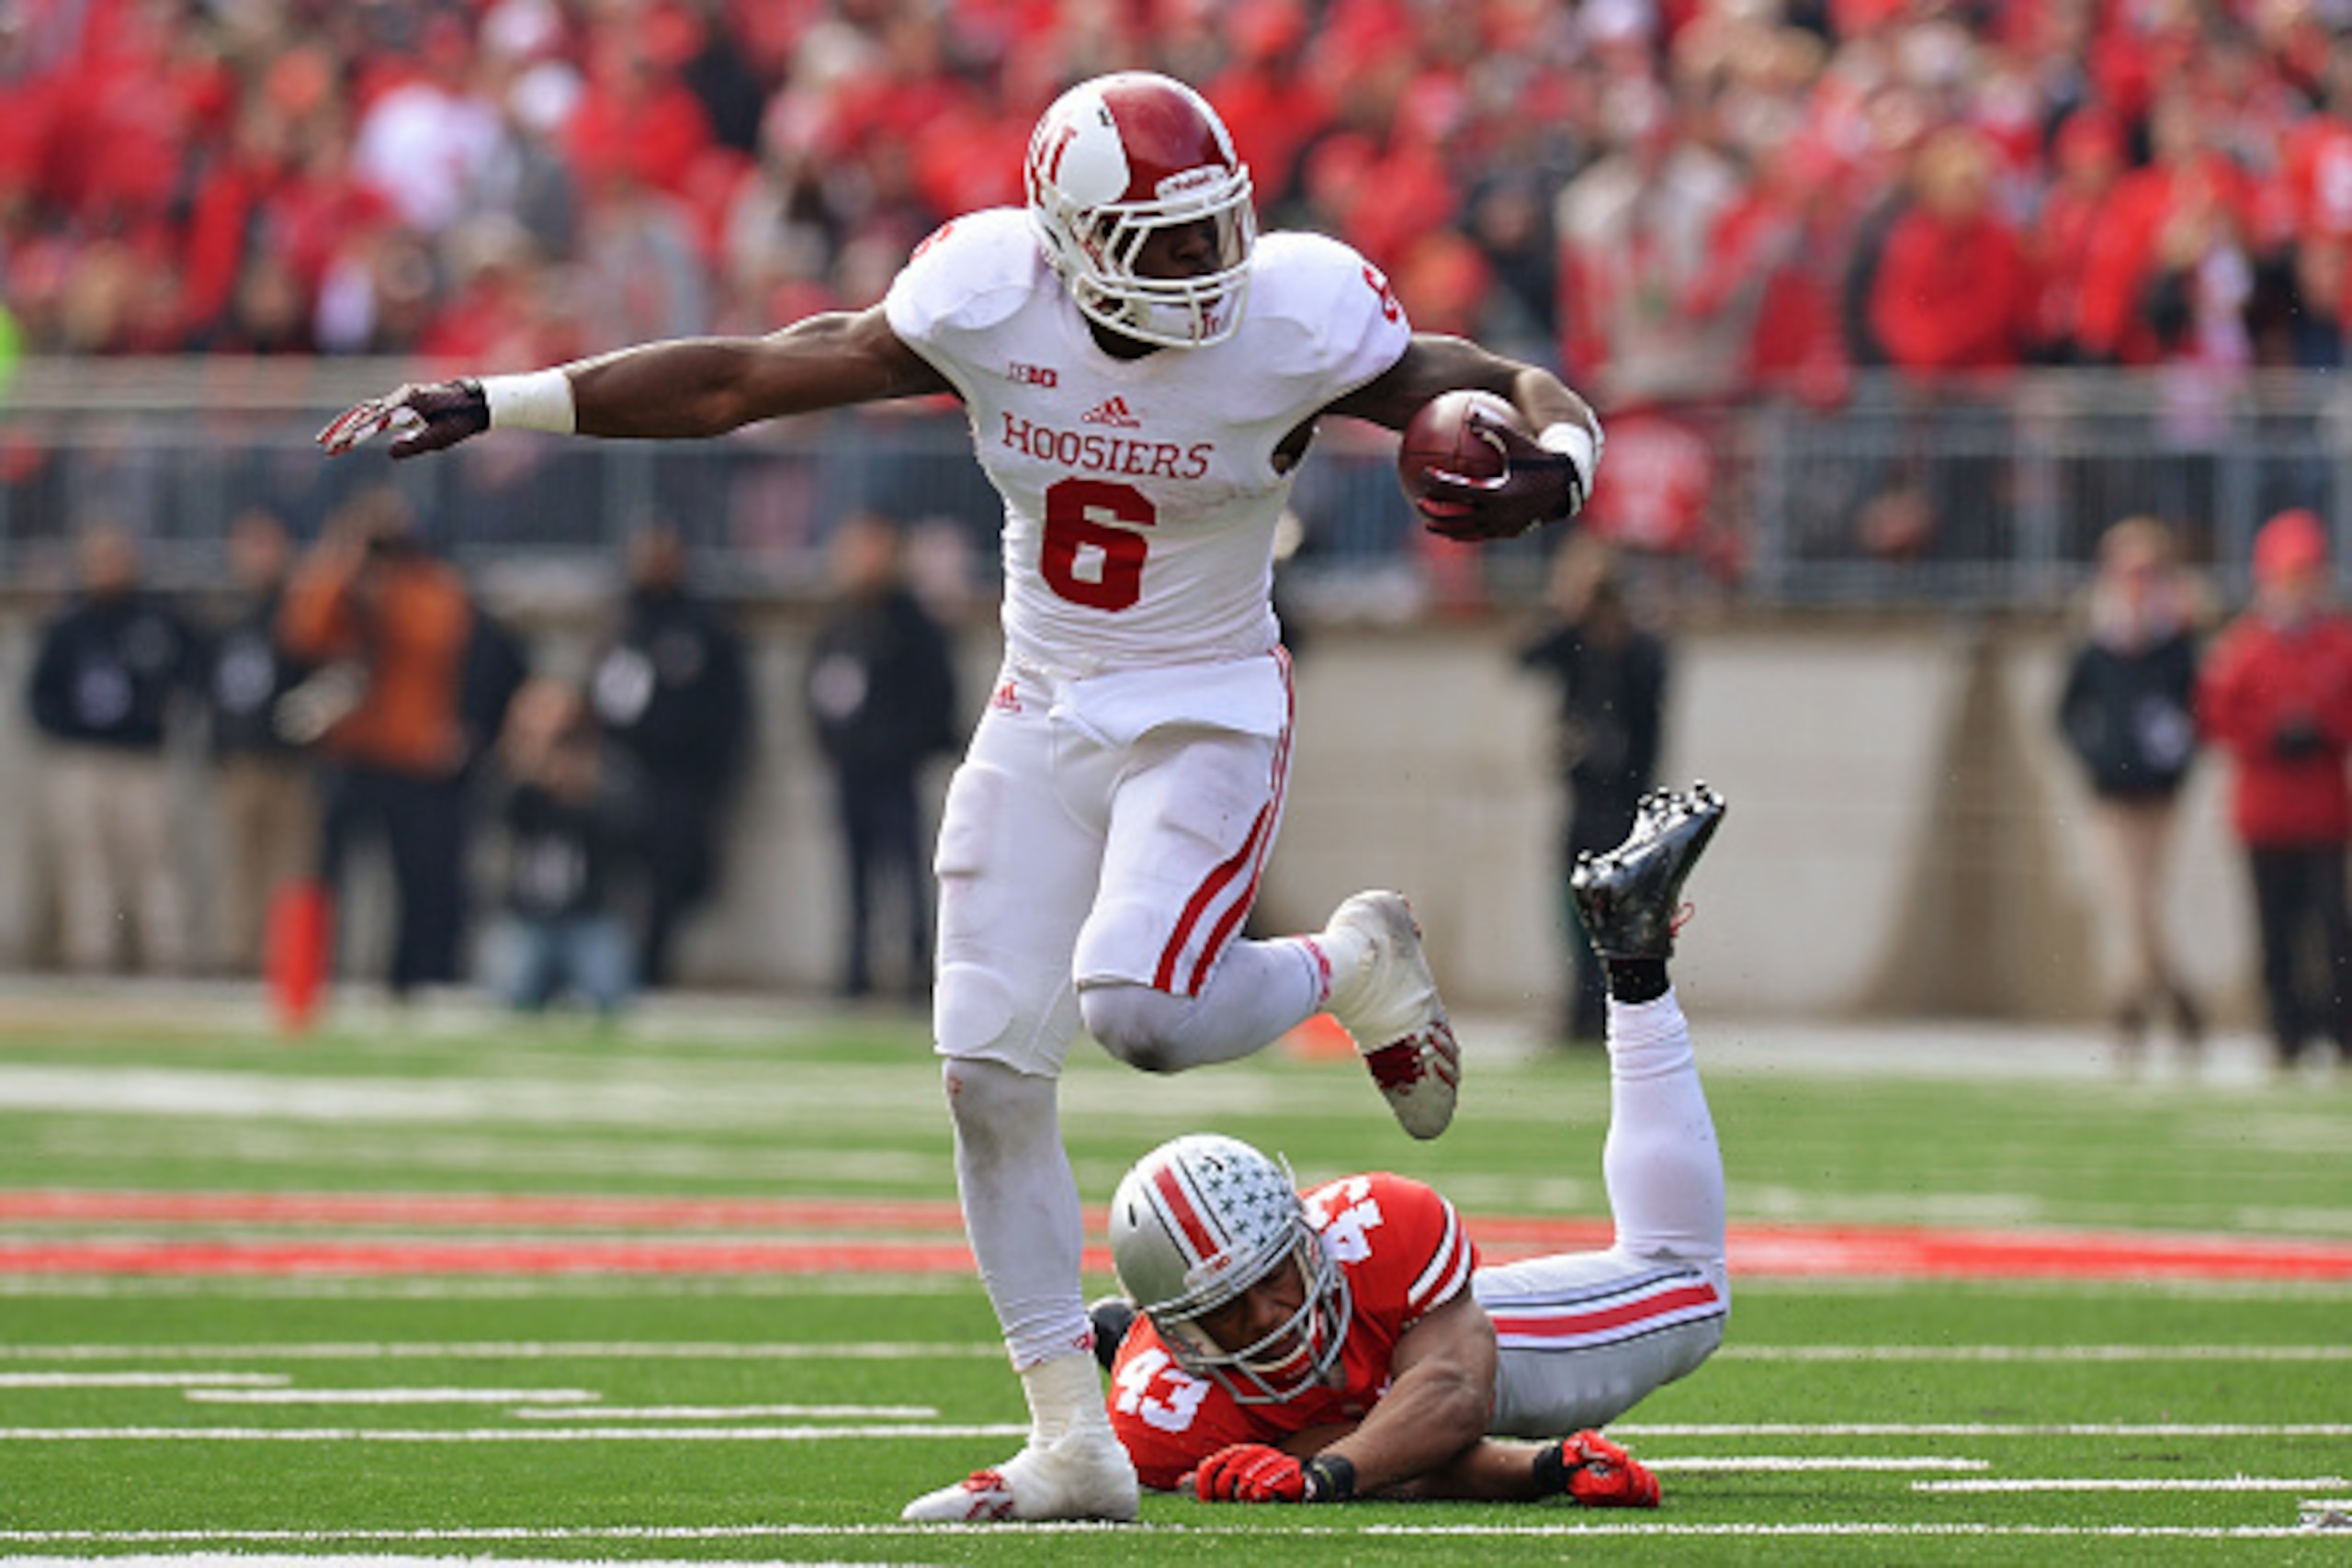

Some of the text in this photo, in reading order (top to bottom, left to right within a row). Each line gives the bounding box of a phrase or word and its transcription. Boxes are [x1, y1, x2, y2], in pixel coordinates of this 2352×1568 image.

[1001, 412, 1215, 479] HOOSIERS
[1040, 476, 1156, 613] 6
[1115, 1347, 1213, 1432] 43
